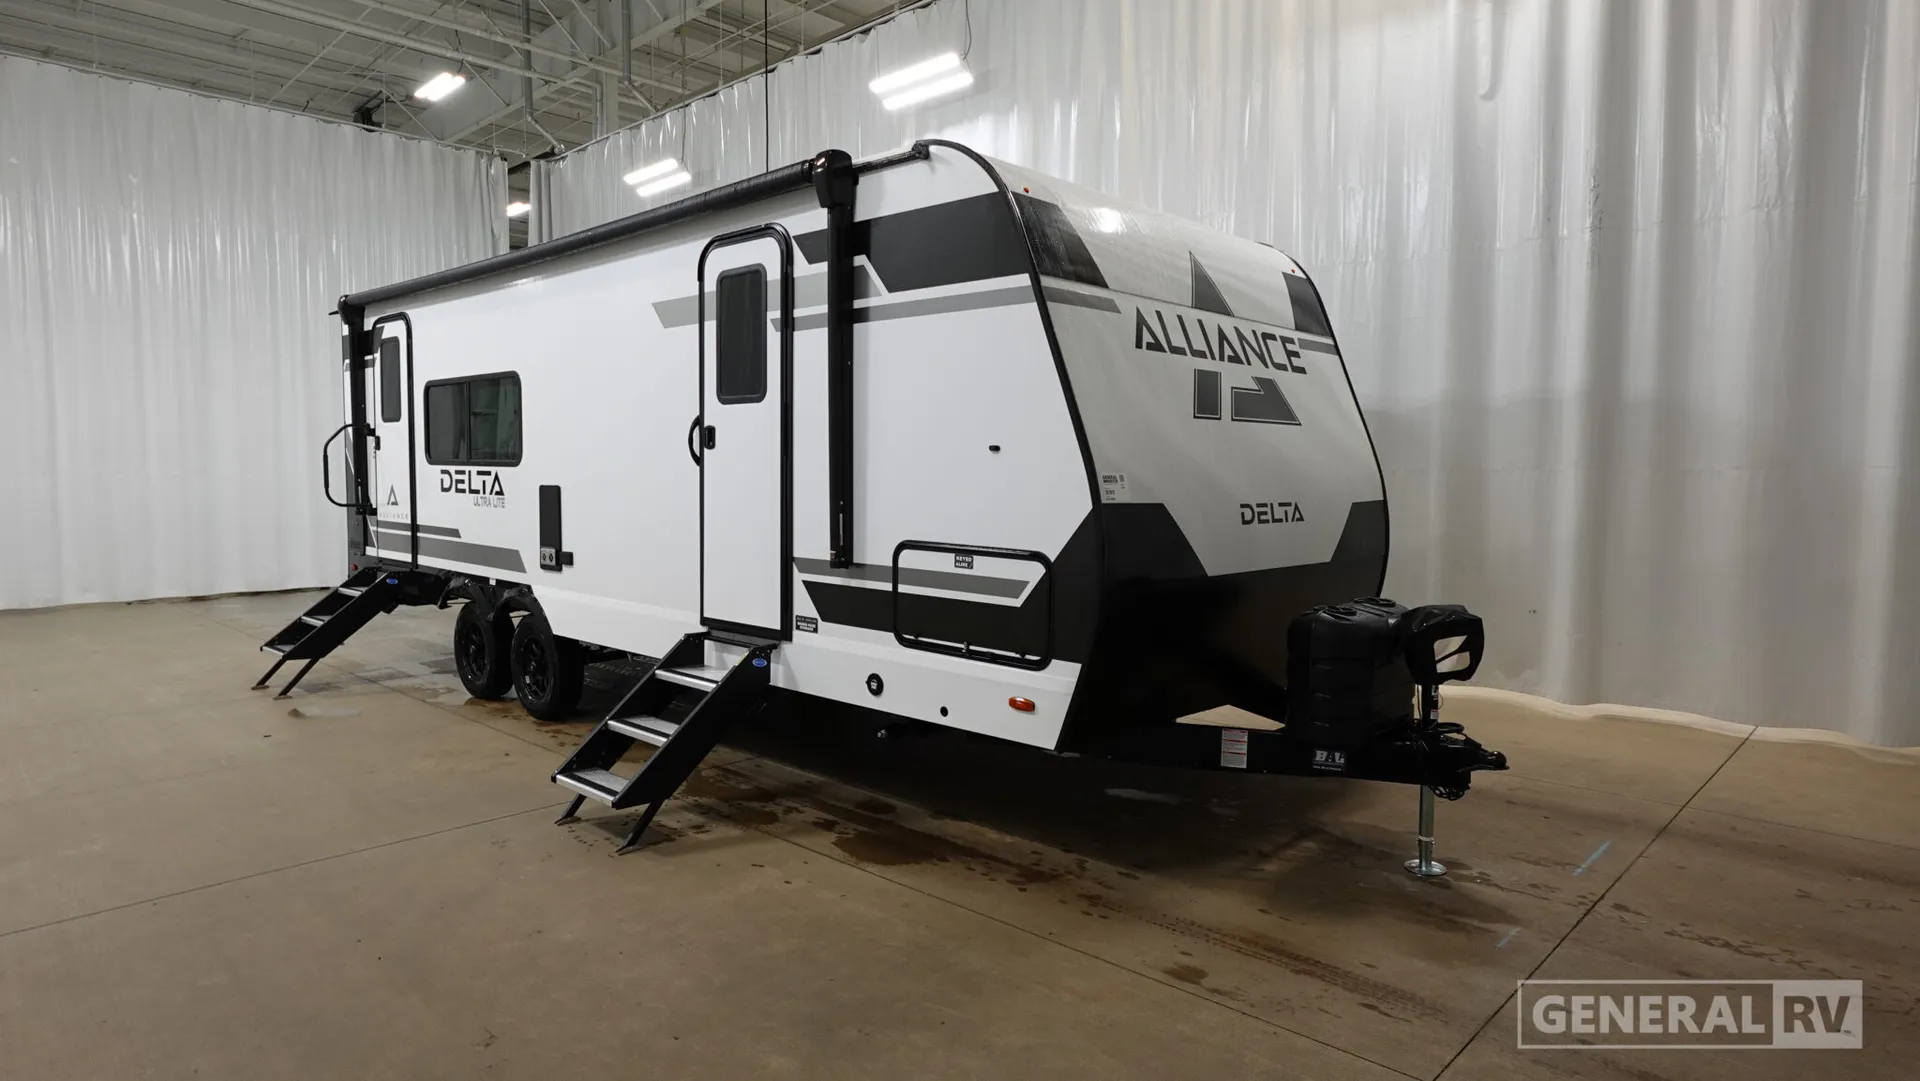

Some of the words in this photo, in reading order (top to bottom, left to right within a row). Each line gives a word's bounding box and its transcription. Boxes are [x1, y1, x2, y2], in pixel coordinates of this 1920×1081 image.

[1135, 306, 1307, 375] ALLIANCE
[440, 469, 505, 496] DELTA
[473, 496, 492, 508] ULTRA
[493, 497, 505, 509] LITE
[1240, 501, 1305, 525] DELTA
